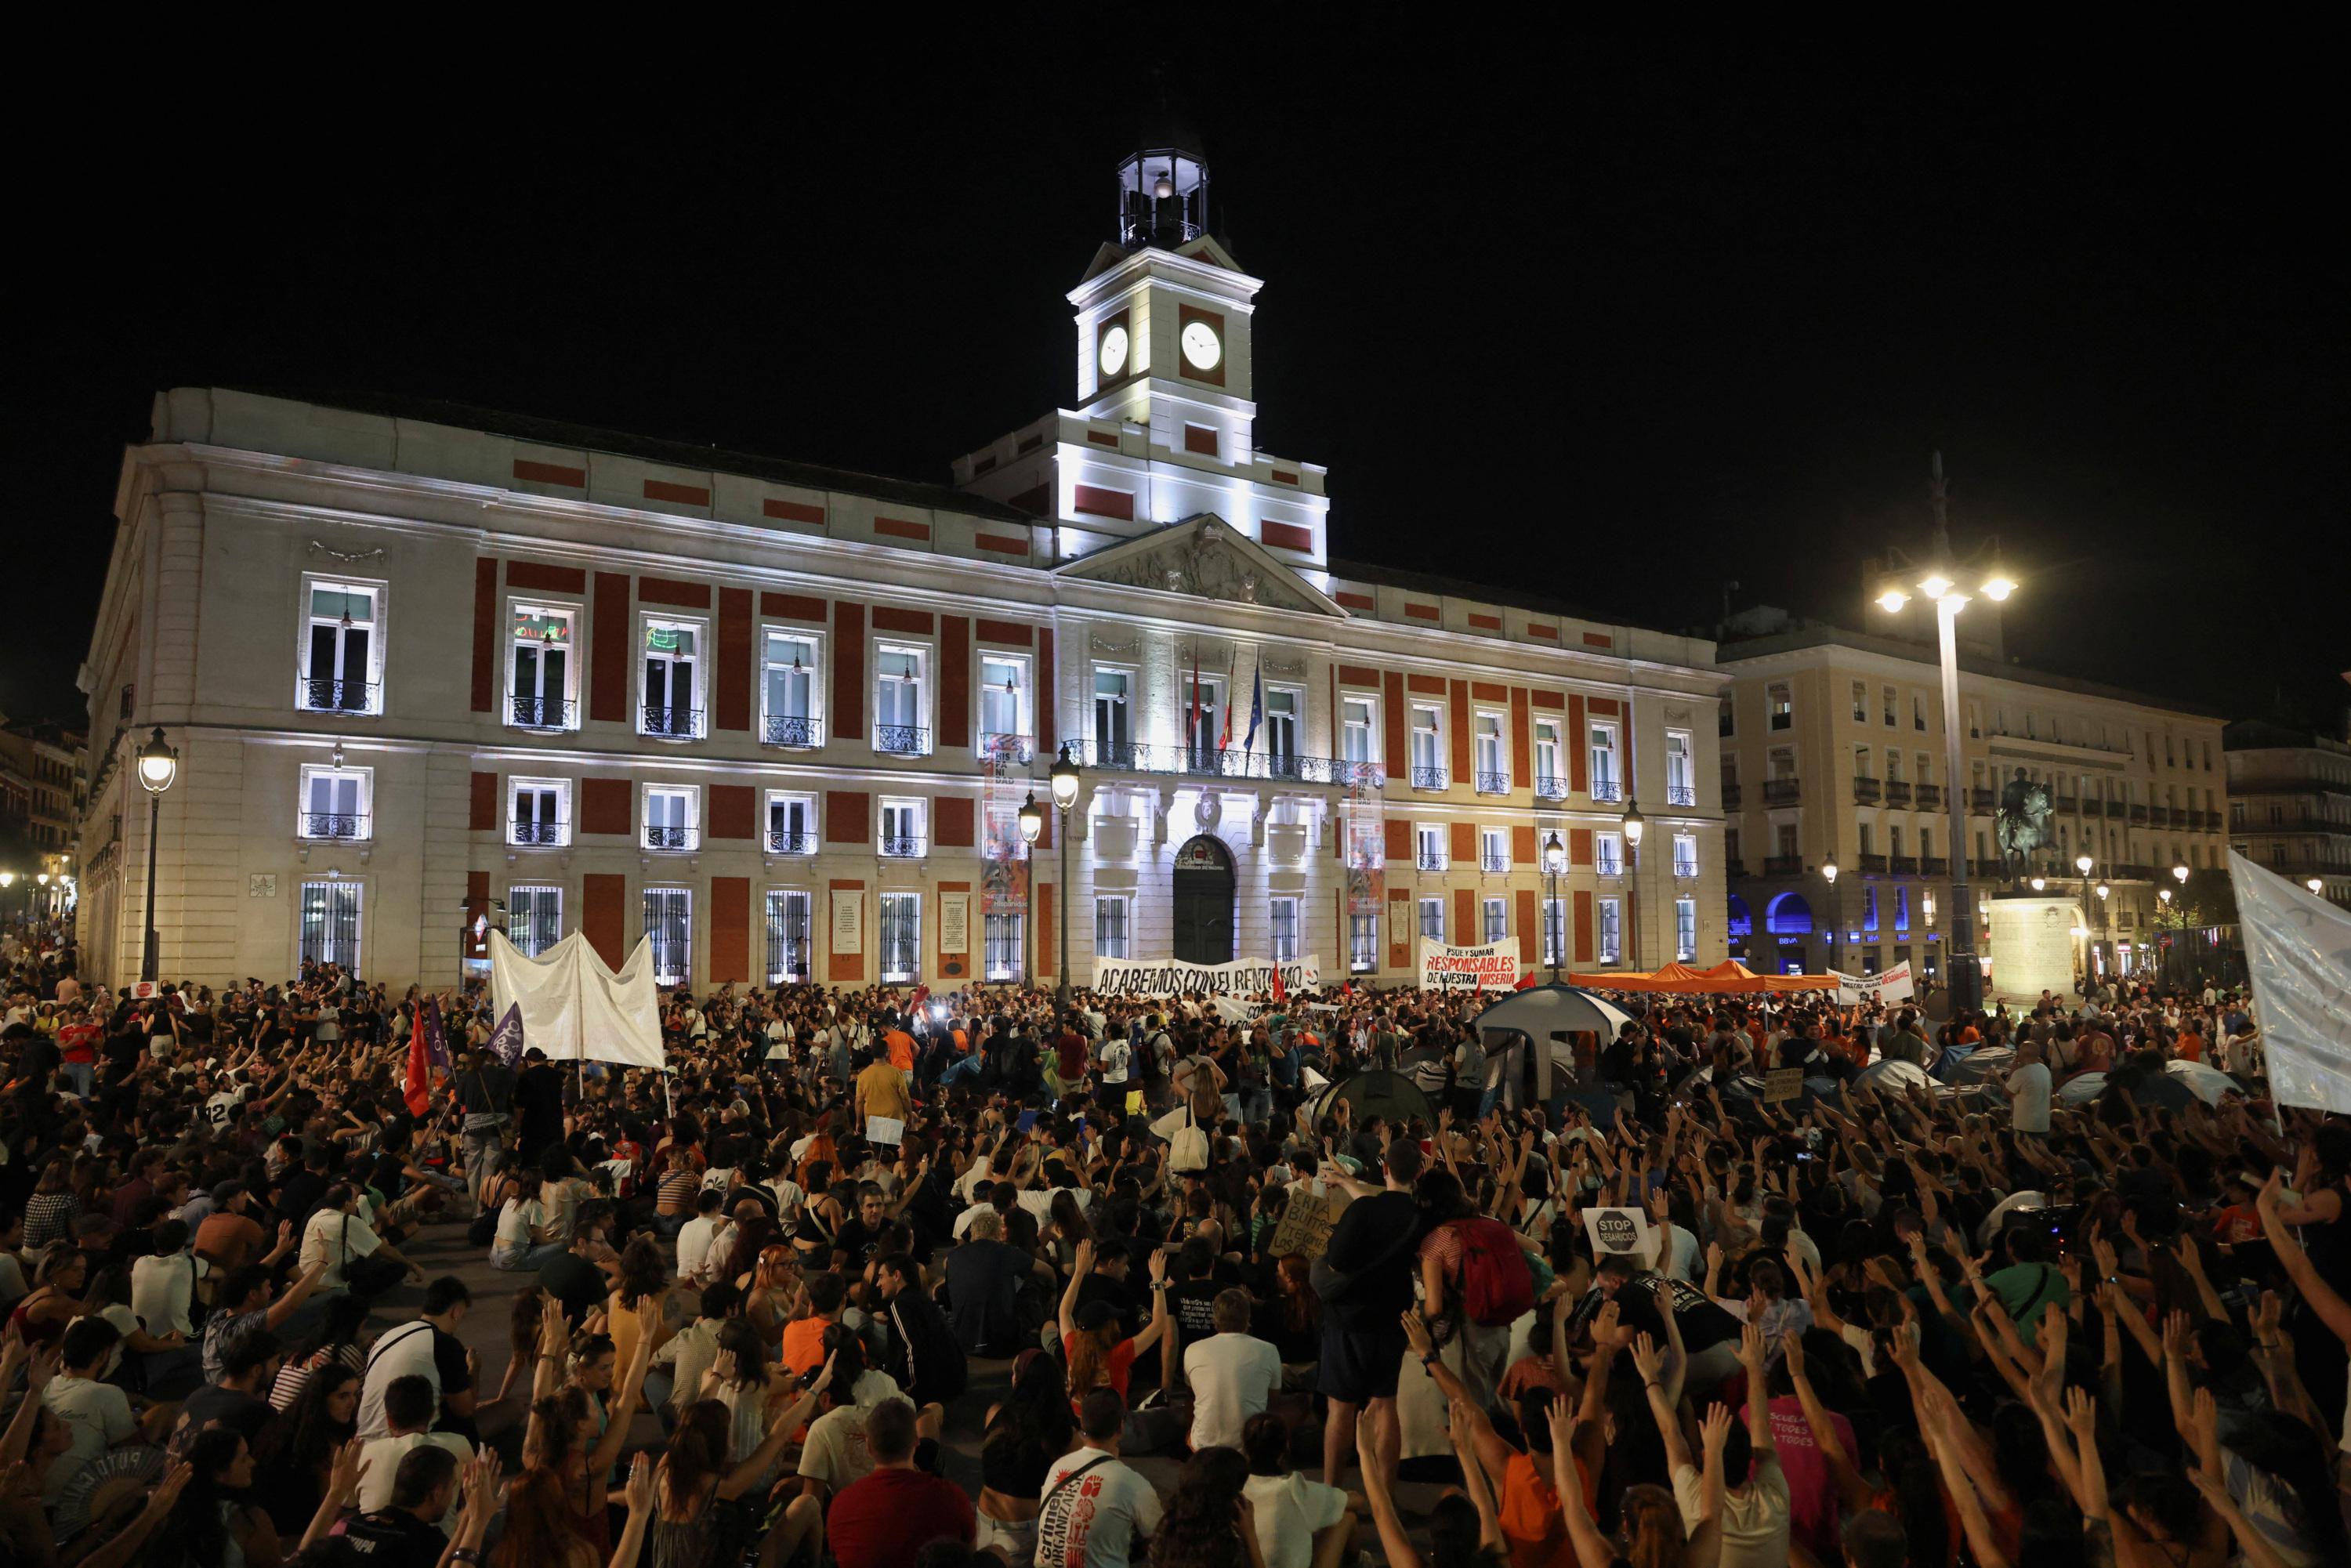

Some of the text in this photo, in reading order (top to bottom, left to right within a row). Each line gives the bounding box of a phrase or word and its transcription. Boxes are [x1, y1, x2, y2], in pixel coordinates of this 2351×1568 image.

[1469, 948, 1494, 957] SUMAR
[1427, 956, 1515, 972] RESPONSABLES
[1099, 967, 1183, 997] ACABEMOS
[1183, 969, 1216, 993] CON
[1427, 972, 1437, 983] DE
[1479, 972, 1515, 985] MISERIA
[1599, 1220, 1632, 1231] STOP
[1600, 1232, 1637, 1242] DESAHUCIOS
